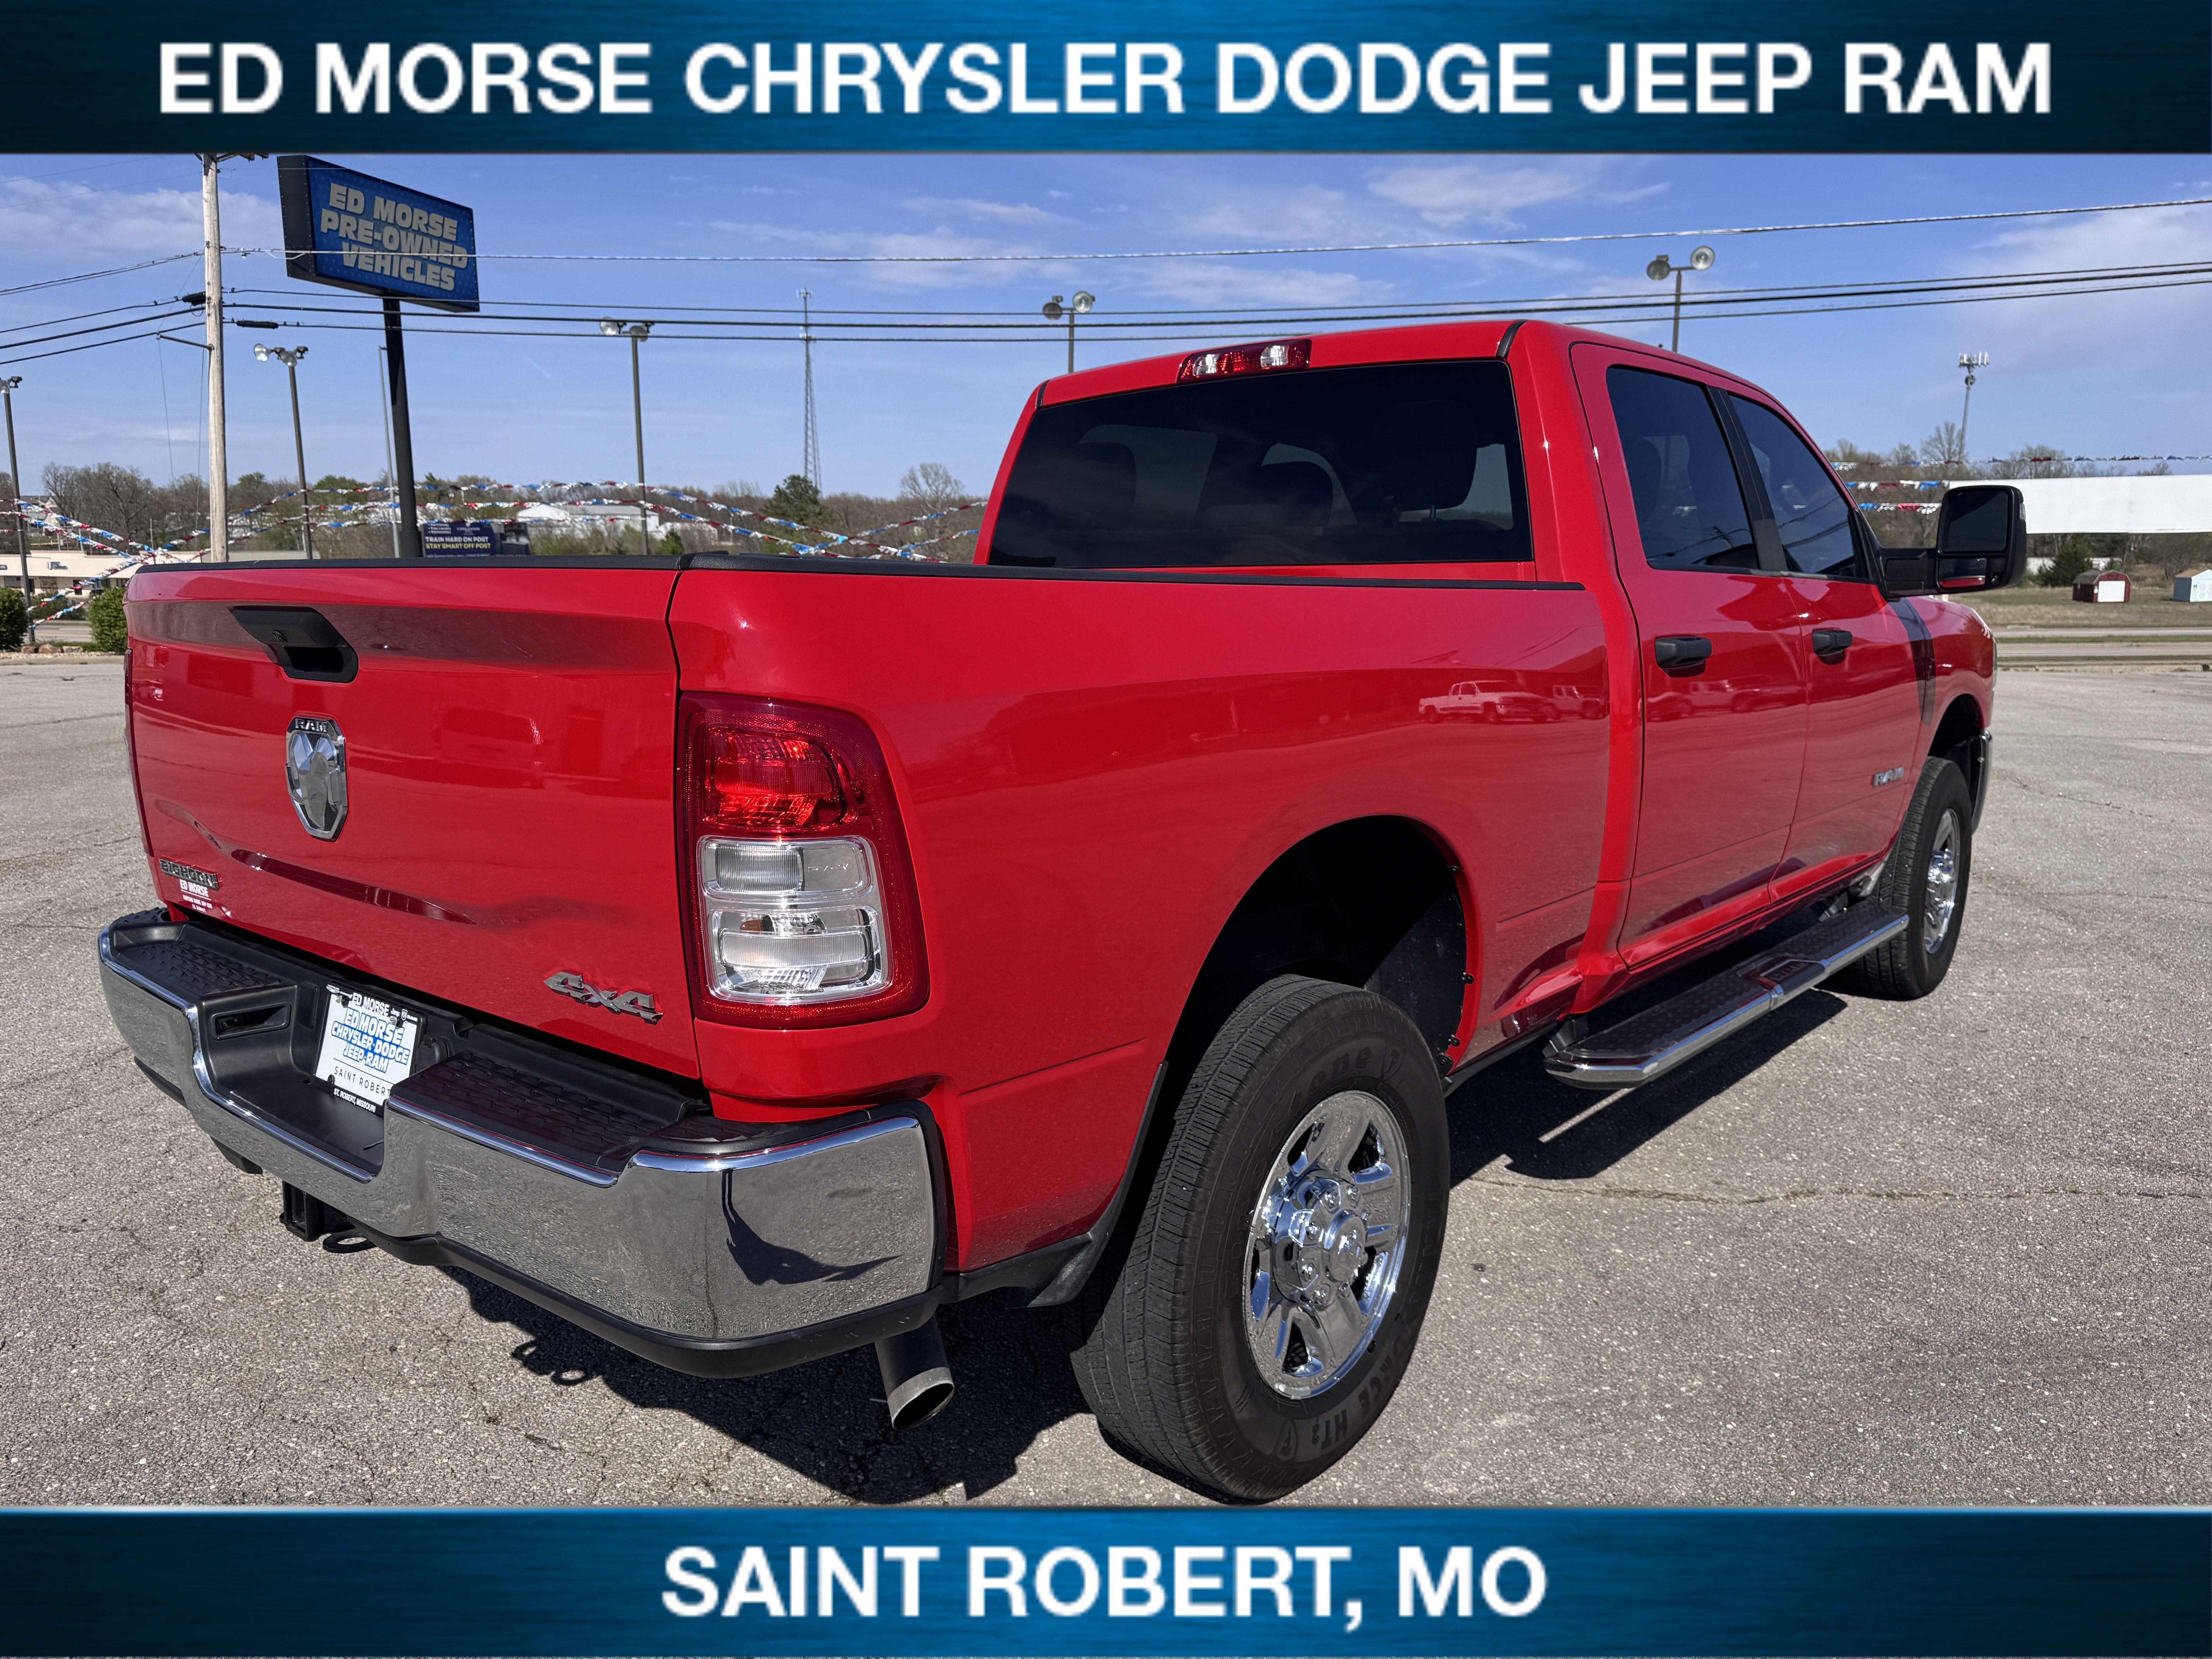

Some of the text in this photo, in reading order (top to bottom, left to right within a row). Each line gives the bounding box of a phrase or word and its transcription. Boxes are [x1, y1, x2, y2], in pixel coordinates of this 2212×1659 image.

[329, 182, 458, 241] ED MORSE
[320, 208, 468, 269] PRE-OWNED
[342, 242, 455, 291] VEHICLES
[295, 718, 328, 733] RAM
[1873, 766, 1904, 788] RAM
[179, 878, 209, 898] ED MORSE
[351, 993, 362, 1006] ED
[363, 996, 390, 1017] MORSE
[344, 1007, 405, 1046] ED MORSE
[334, 1066, 390, 1097] SAINT ROBERT
[356, 1097, 376, 1113] MISSOURI
